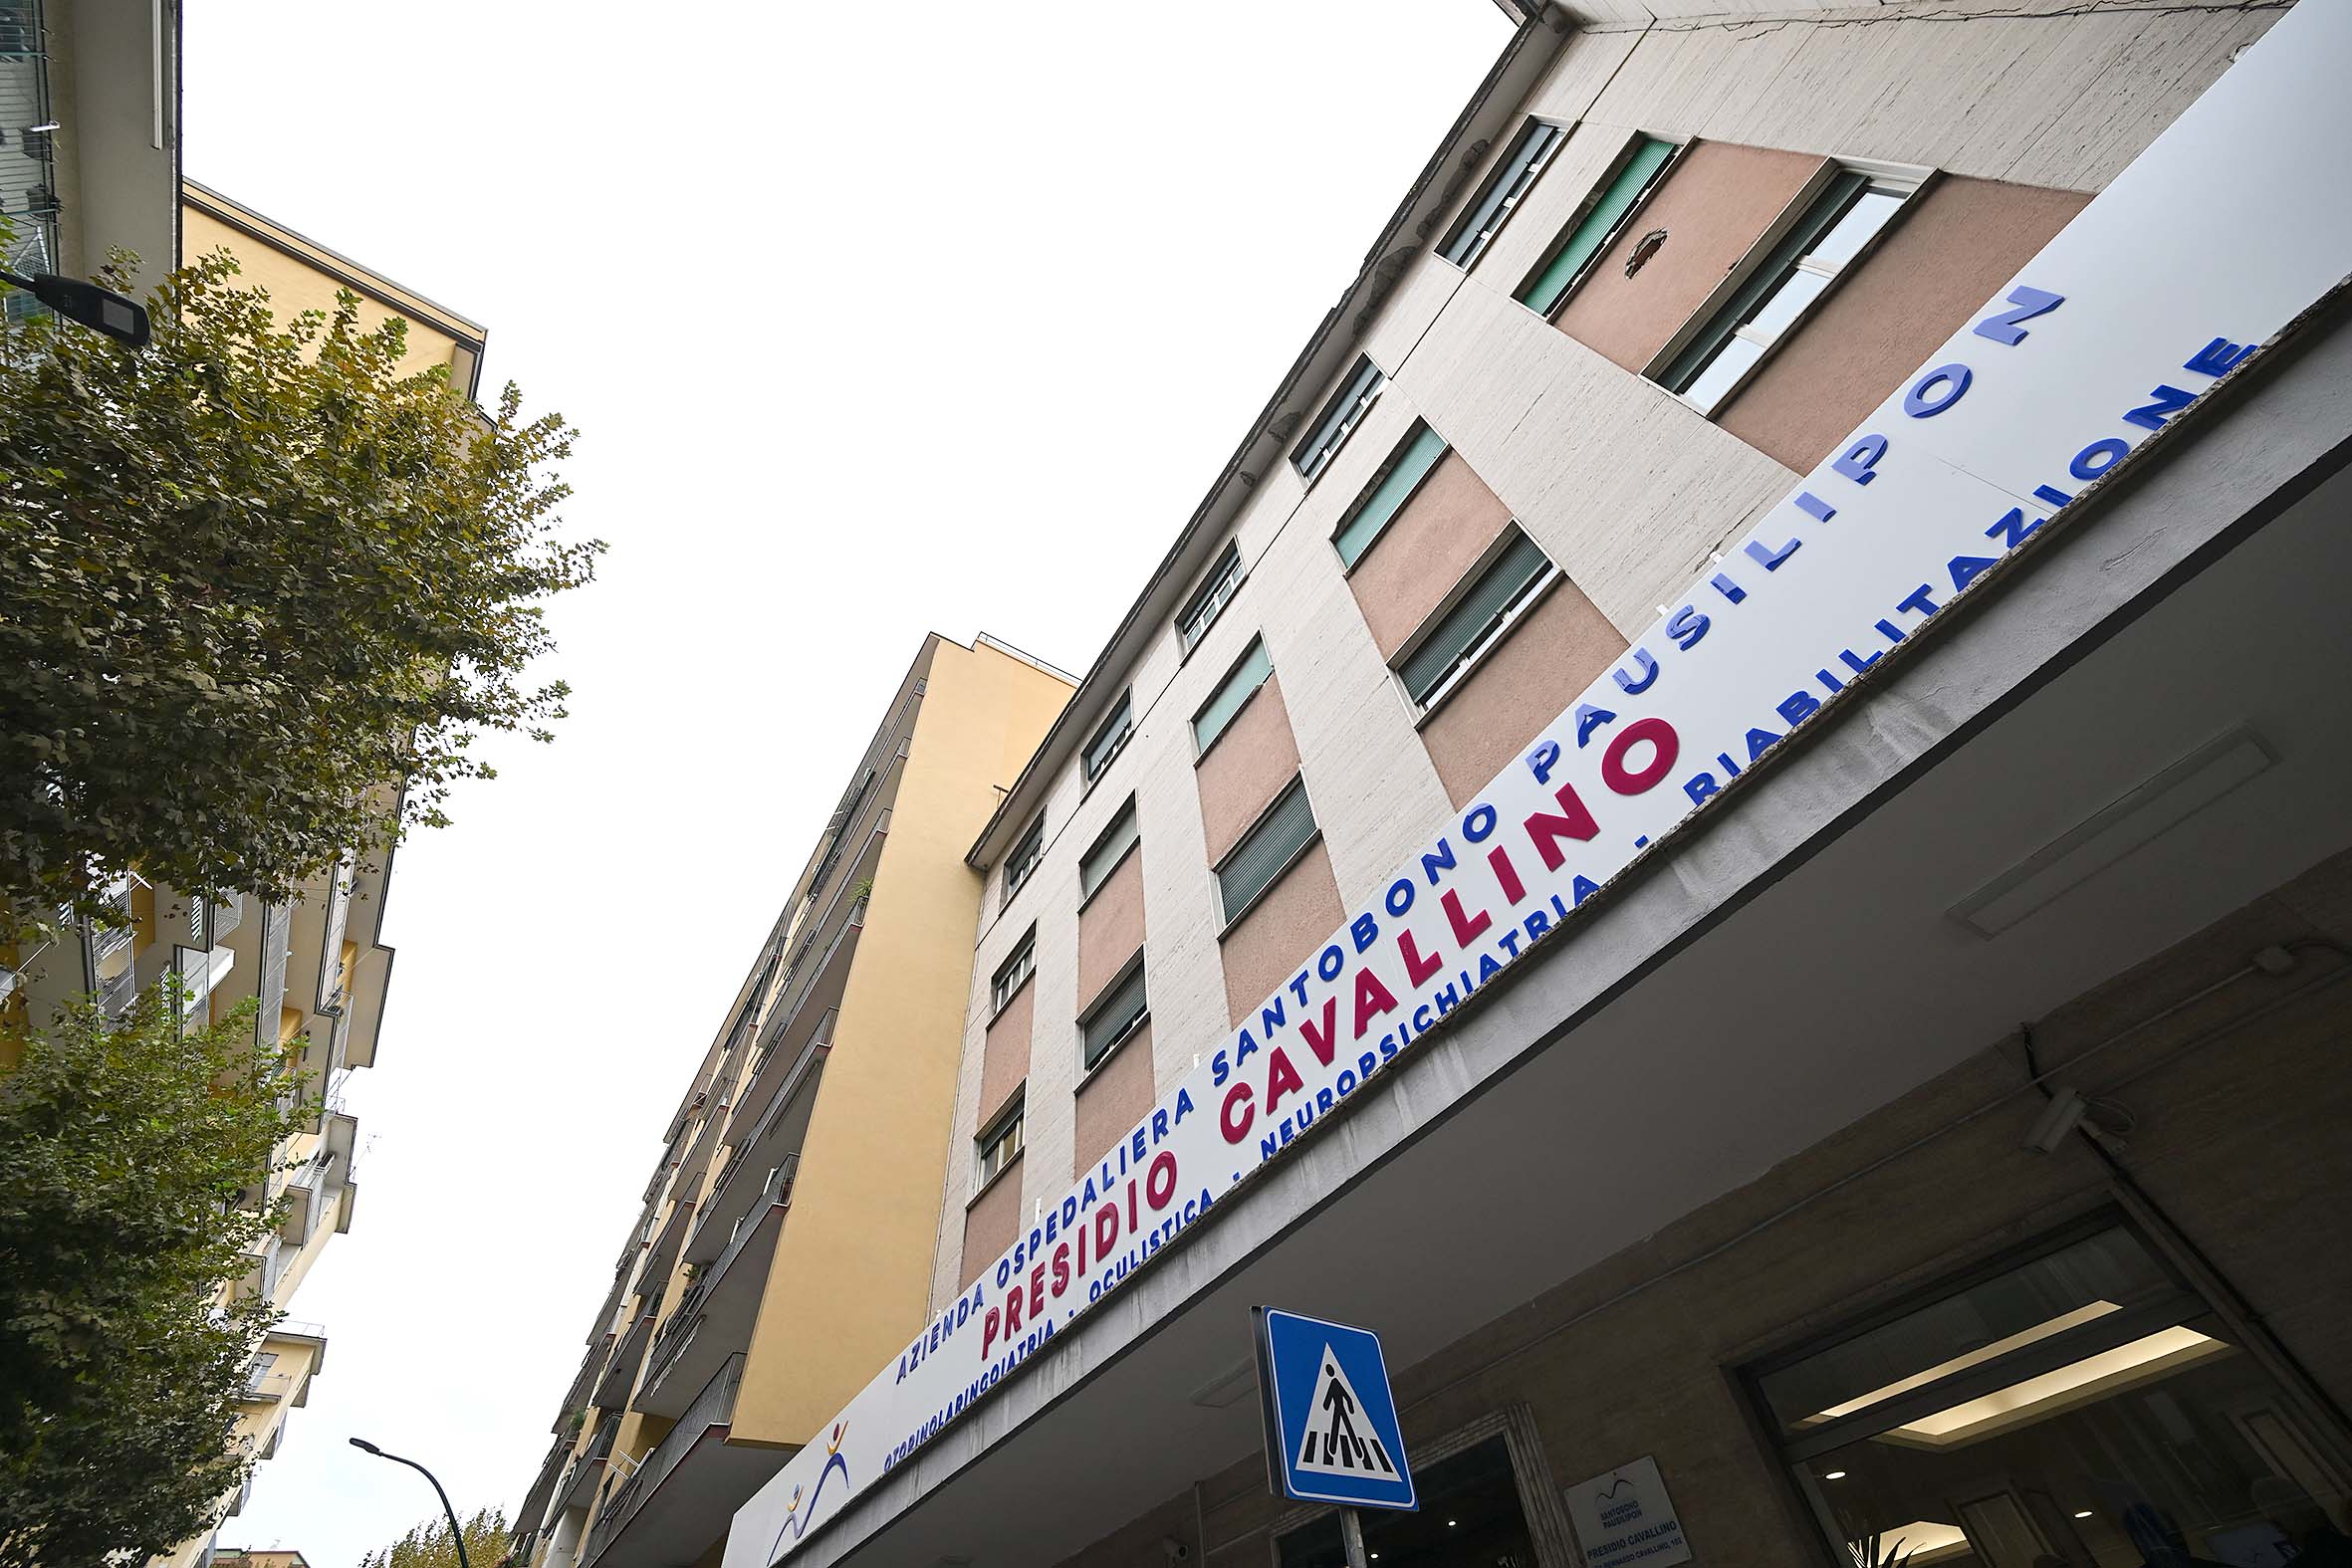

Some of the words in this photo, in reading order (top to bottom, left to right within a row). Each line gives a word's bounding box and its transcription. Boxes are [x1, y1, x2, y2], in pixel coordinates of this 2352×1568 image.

[883, 1318, 1056, 1472] OTORINOLARINGOIATRIA
[1088, 1187, 1214, 1303] OCULISTICA
[1260, 874, 1600, 1162] NEUROPSICHIATRIA
[1682, 336, 2260, 807] RIABILITAZIONE
[896, 1281, 985, 1385] AZIENDA
[996, 1086, 1195, 1289] OSPEDALIERA
[1211, 802, 1498, 1087] SANTOBONO
[1526, 285, 2066, 785] PAUSILIPON
[981, 1151, 1177, 1361] PRESIDIO
[1220, 718, 1679, 1144] CAVALLINO
[1586, 1538, 1626, 1560] PRESIDIO
[1628, 1520, 1678, 1546] CAVALLINO
